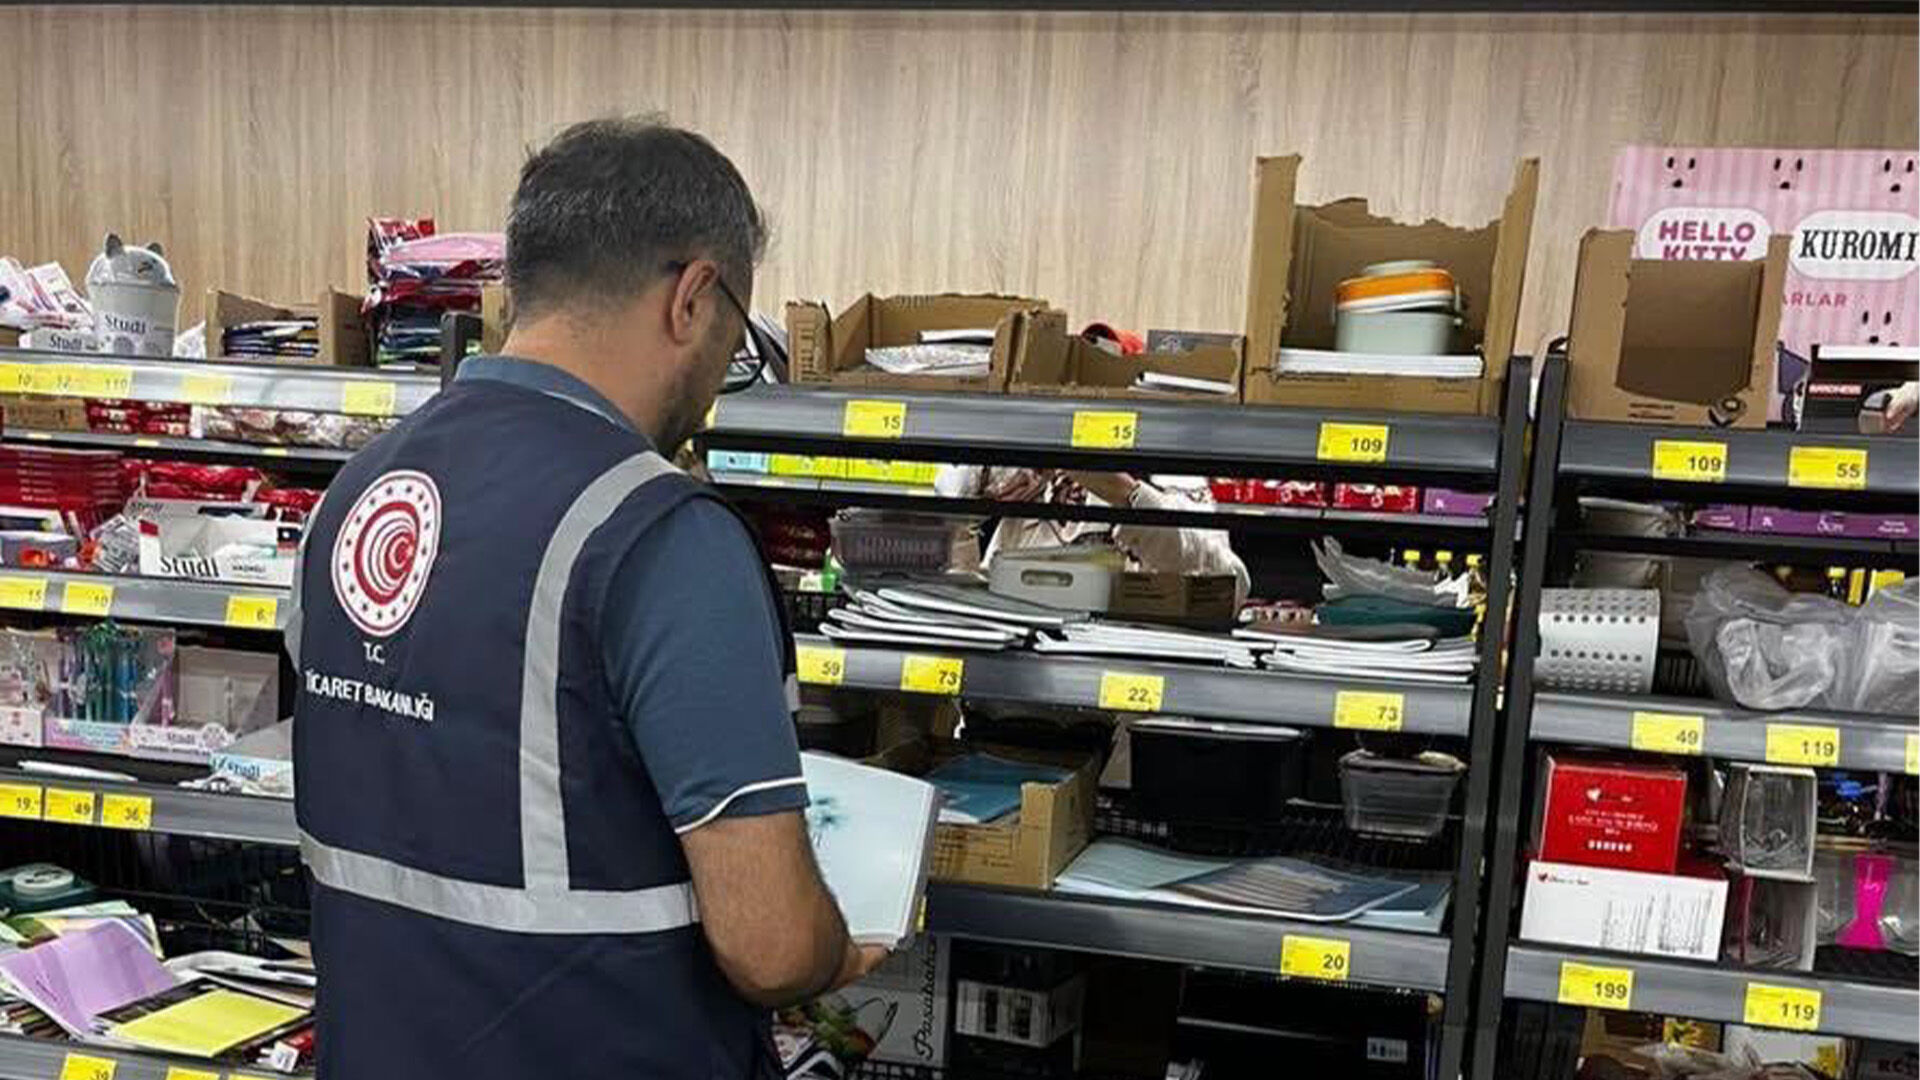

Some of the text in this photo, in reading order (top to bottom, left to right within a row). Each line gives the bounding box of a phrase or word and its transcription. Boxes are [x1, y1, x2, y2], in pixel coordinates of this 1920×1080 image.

[1658, 220, 1755, 243] HELLO
[1798, 229, 1919, 262] KUROMI
[1781, 291, 1848, 307] RLAR
[882, 414, 901, 430] 15
[1112, 424, 1132, 440] 15
[1351, 437, 1384, 454] 109
[1687, 455, 1722, 472] 109
[1836, 463, 1861, 479] 55
[821, 660, 842, 677] 59
[938, 671, 959, 686] 73
[364, 683, 435, 721] BAKANLIĞI
[1377, 706, 1398, 722] 73
[1675, 730, 1699, 746] 49
[1801, 740, 1835, 757] 119
[1322, 953, 1345, 970] 20
[1594, 981, 1628, 1000] 199
[1781, 1001, 1815, 1021] 119
